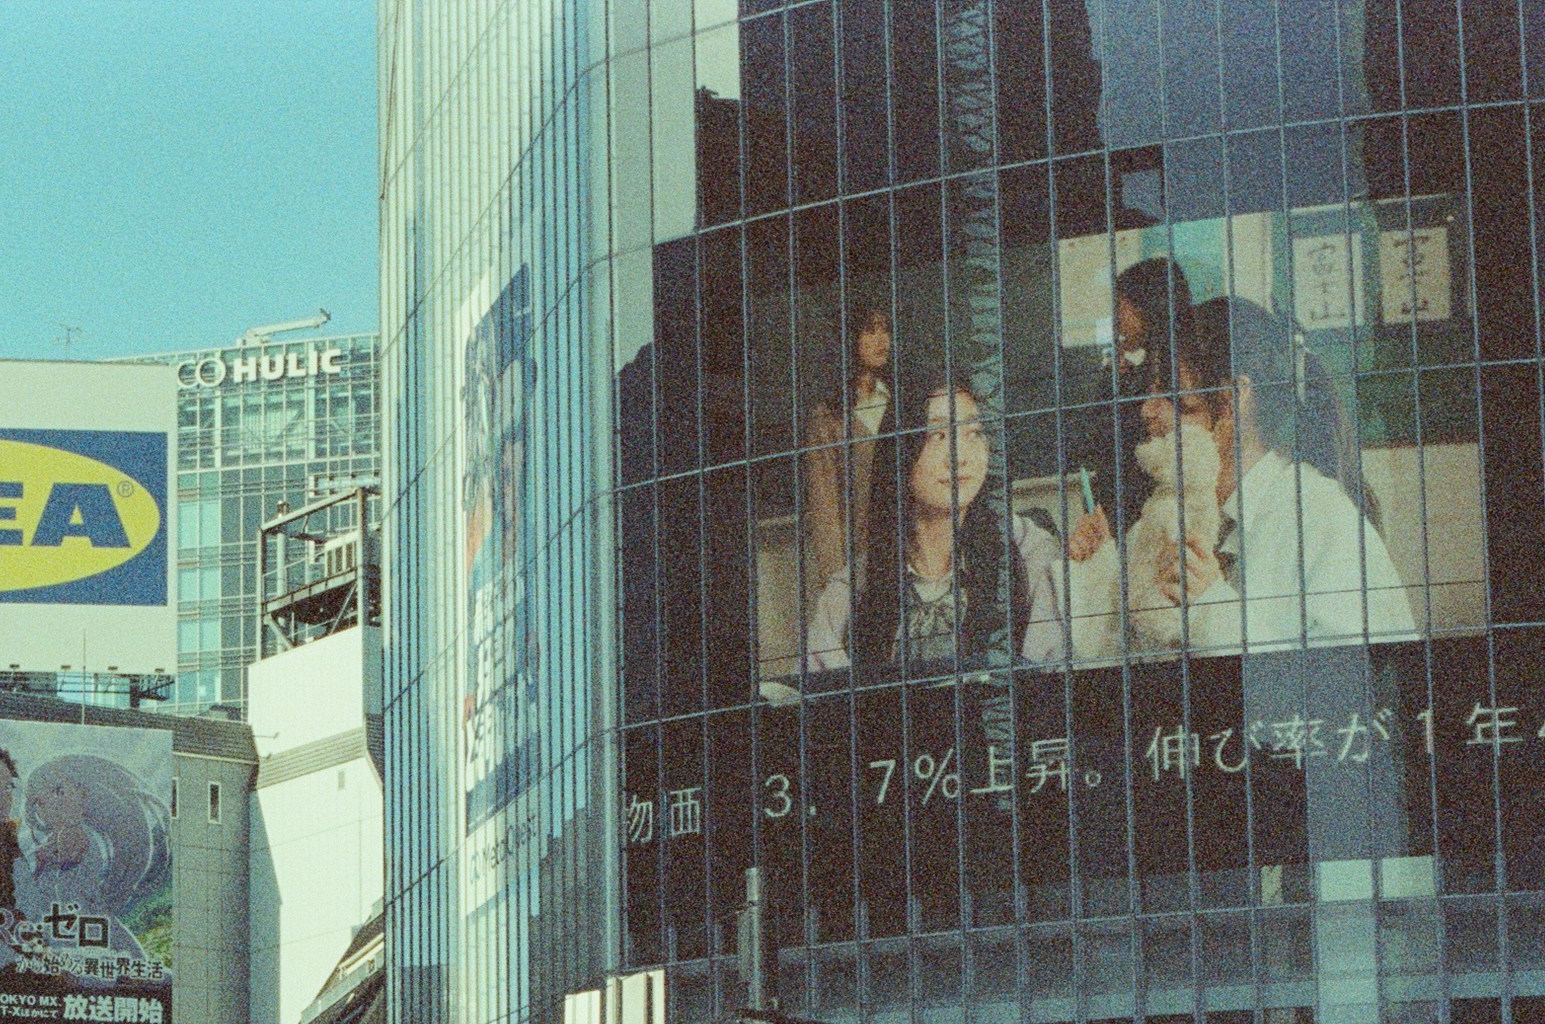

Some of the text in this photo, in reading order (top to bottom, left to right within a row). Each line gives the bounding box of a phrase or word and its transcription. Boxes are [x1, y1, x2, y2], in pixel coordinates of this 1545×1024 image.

[233, 350, 342, 383] HULIC
[63, 995, 163, 1024] 放送開始
